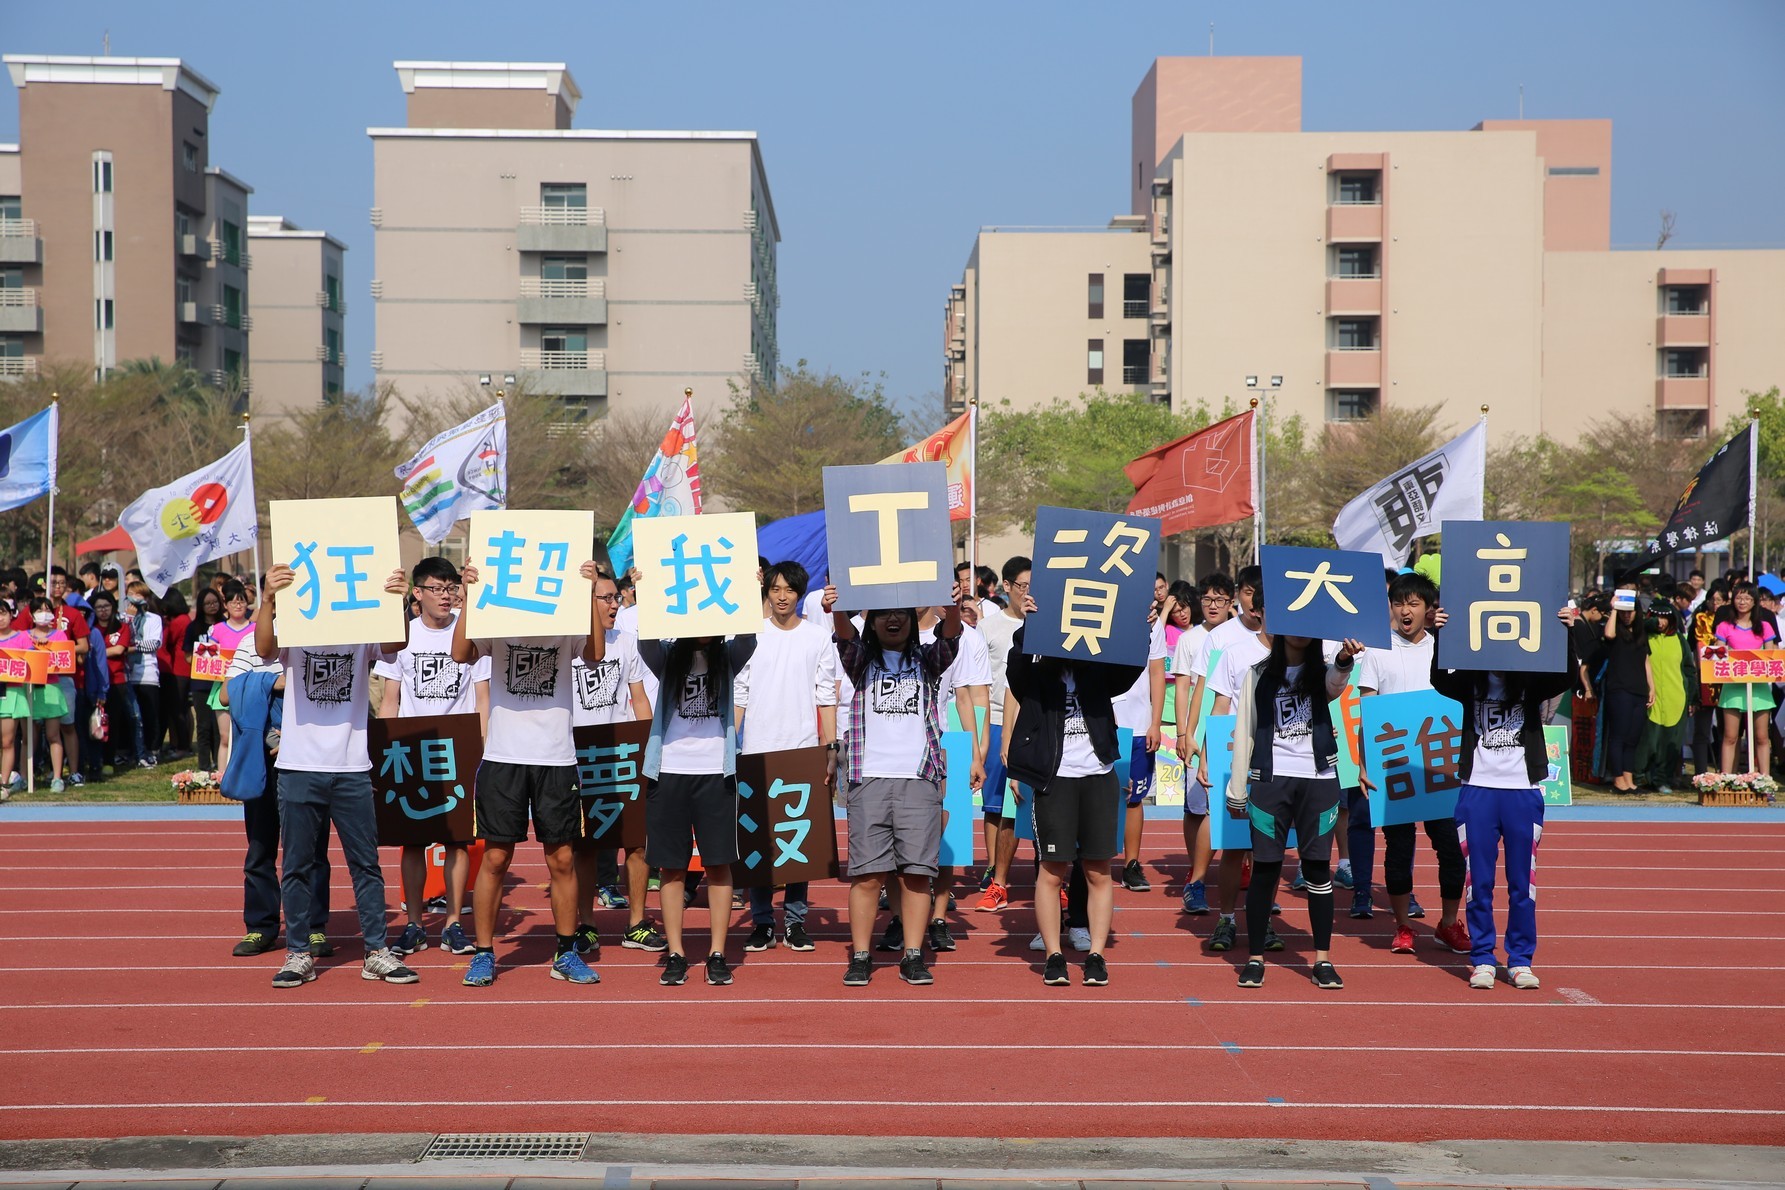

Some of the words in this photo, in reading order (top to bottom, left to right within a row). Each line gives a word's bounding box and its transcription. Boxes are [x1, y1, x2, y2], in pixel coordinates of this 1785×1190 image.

[289, 541, 381, 621] 狂
[476, 530, 569, 616] 超
[660, 533, 739, 616] 我
[1046, 520, 1151, 656] 資
[1285, 561, 1358, 614] 大
[1469, 532, 1541, 653] 高
[195, 657, 232, 676] 財經
[1715, 660, 1784, 677] 法律學系
[380, 738, 465, 820] 想
[576, 743, 640, 840] 夢
[1374, 715, 1462, 801] 誰
